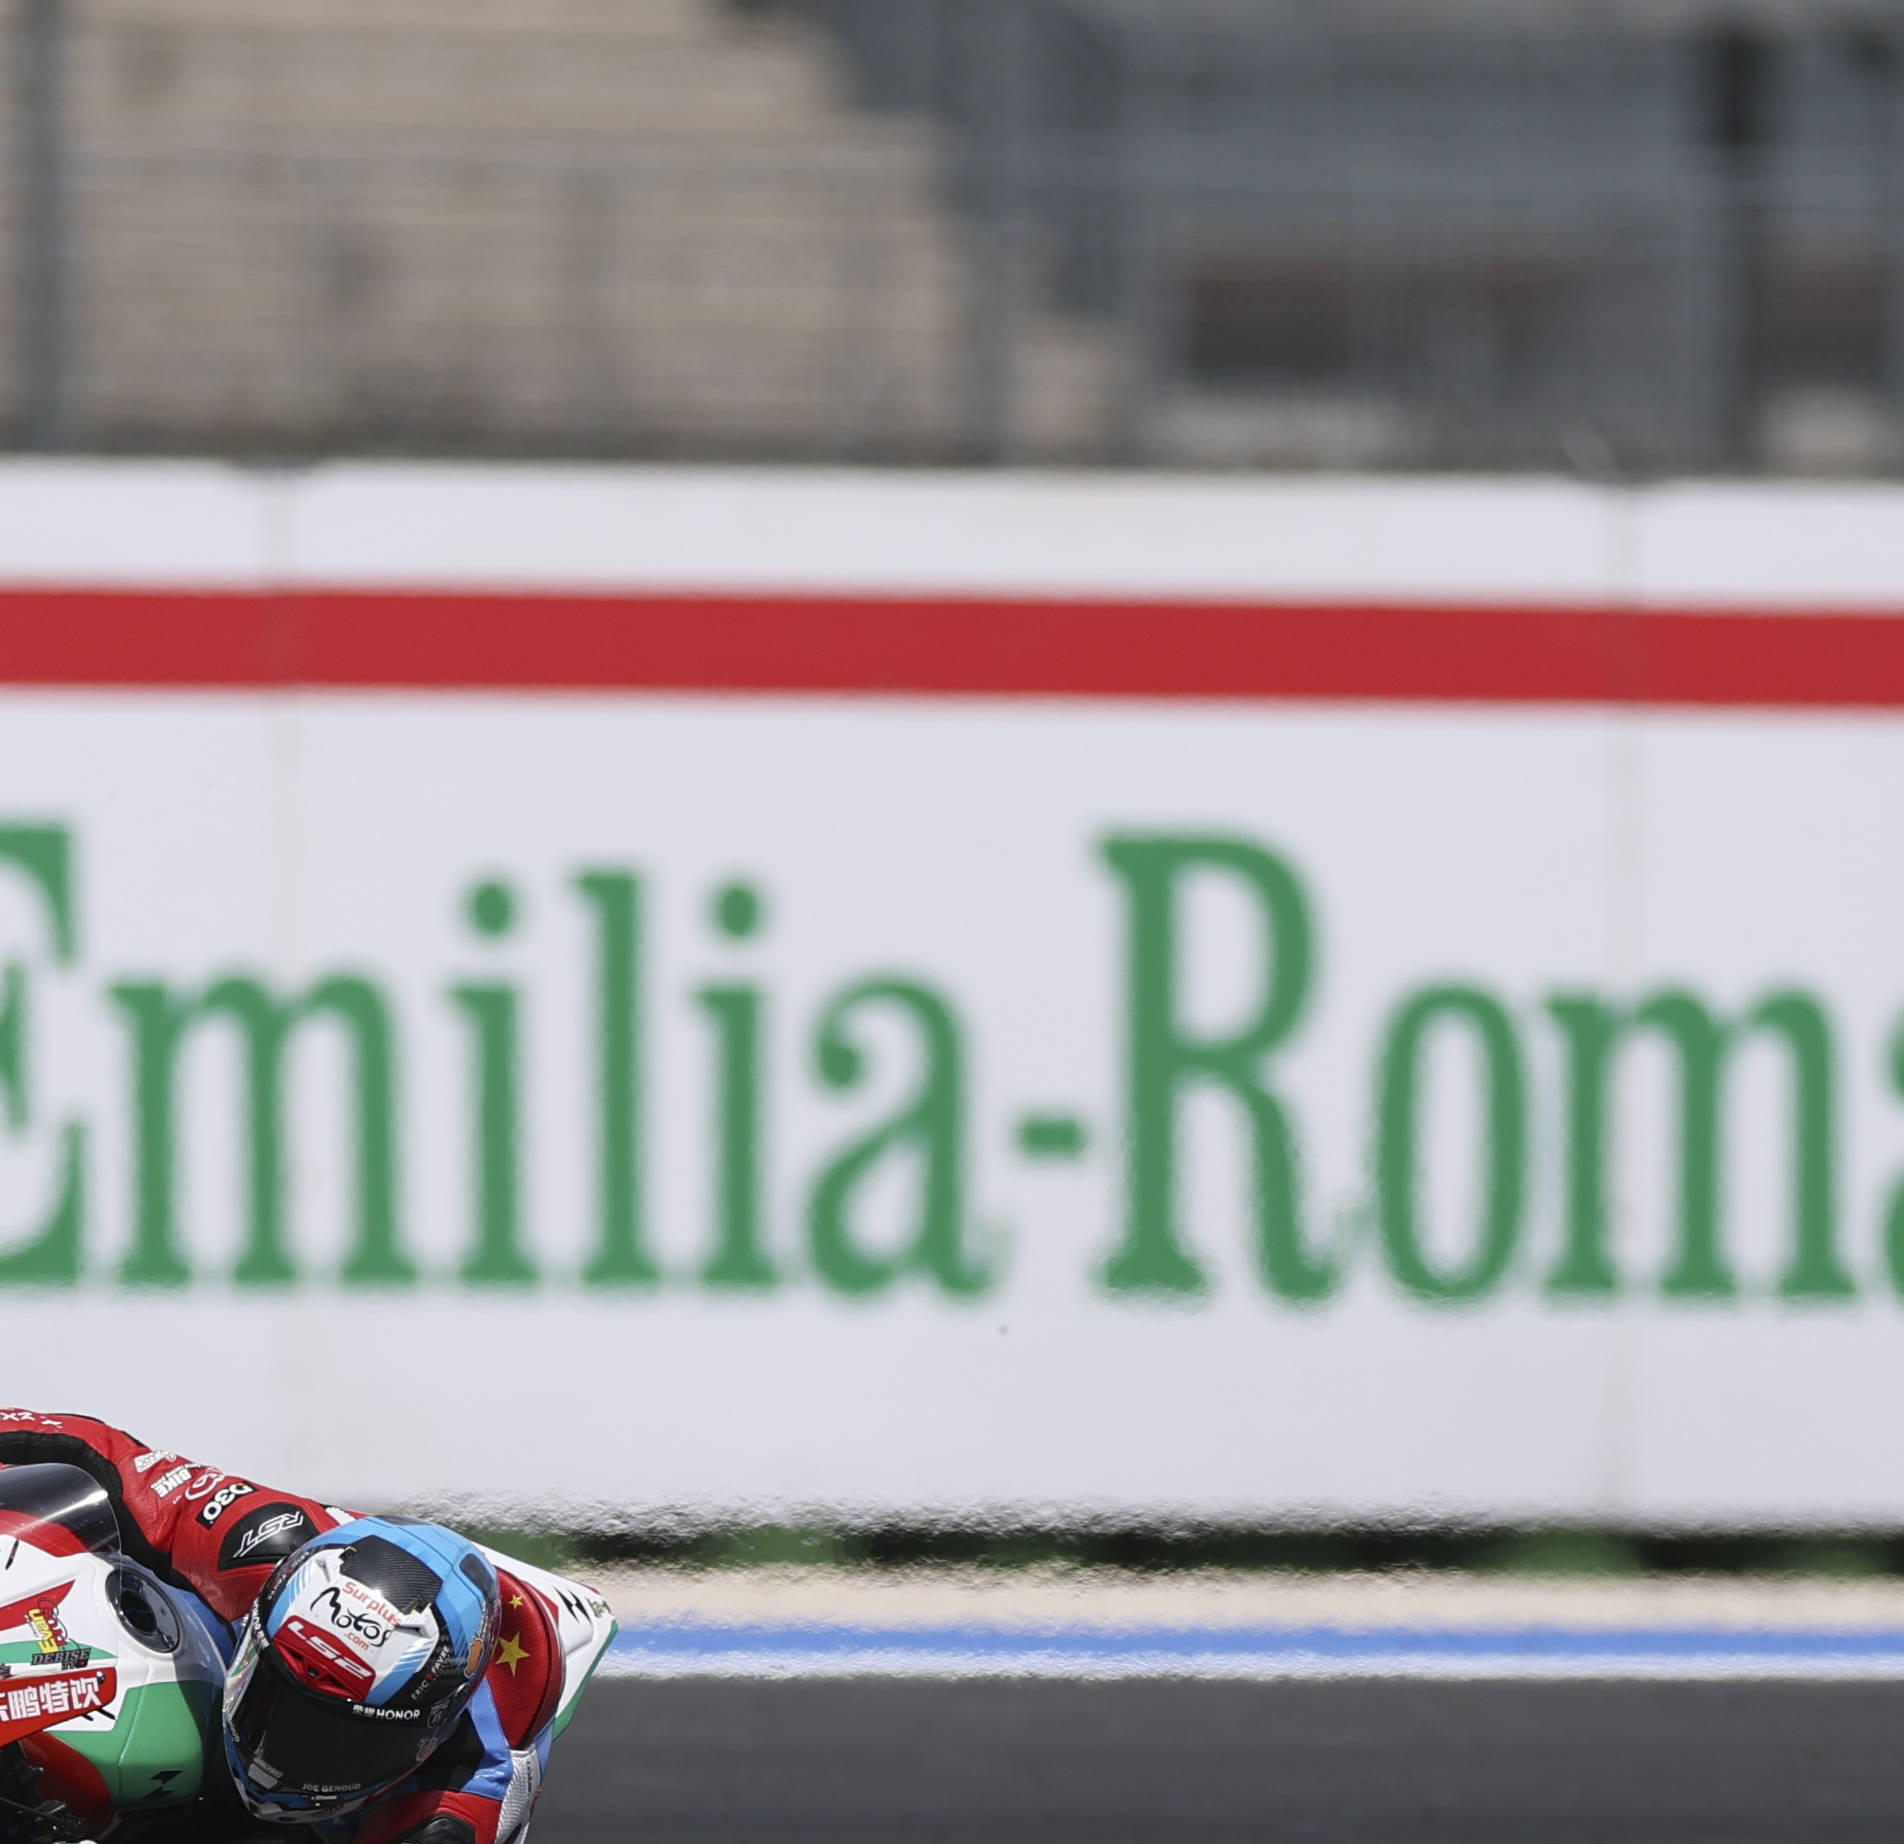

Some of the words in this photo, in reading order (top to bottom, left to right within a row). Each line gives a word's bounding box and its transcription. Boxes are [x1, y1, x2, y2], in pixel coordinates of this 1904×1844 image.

[310, 1587, 394, 1647] Motos
[343, 1582, 402, 1627] Surplus
[288, 1621, 374, 1680] LS2
[411, 1678, 430, 1700] ERIC
[430, 1646, 450, 1676] FAVRE
[376, 1708, 421, 1721] HONOR
[302, 1783, 320, 1792] JOE
[322, 1784, 362, 1793] GENOUD
